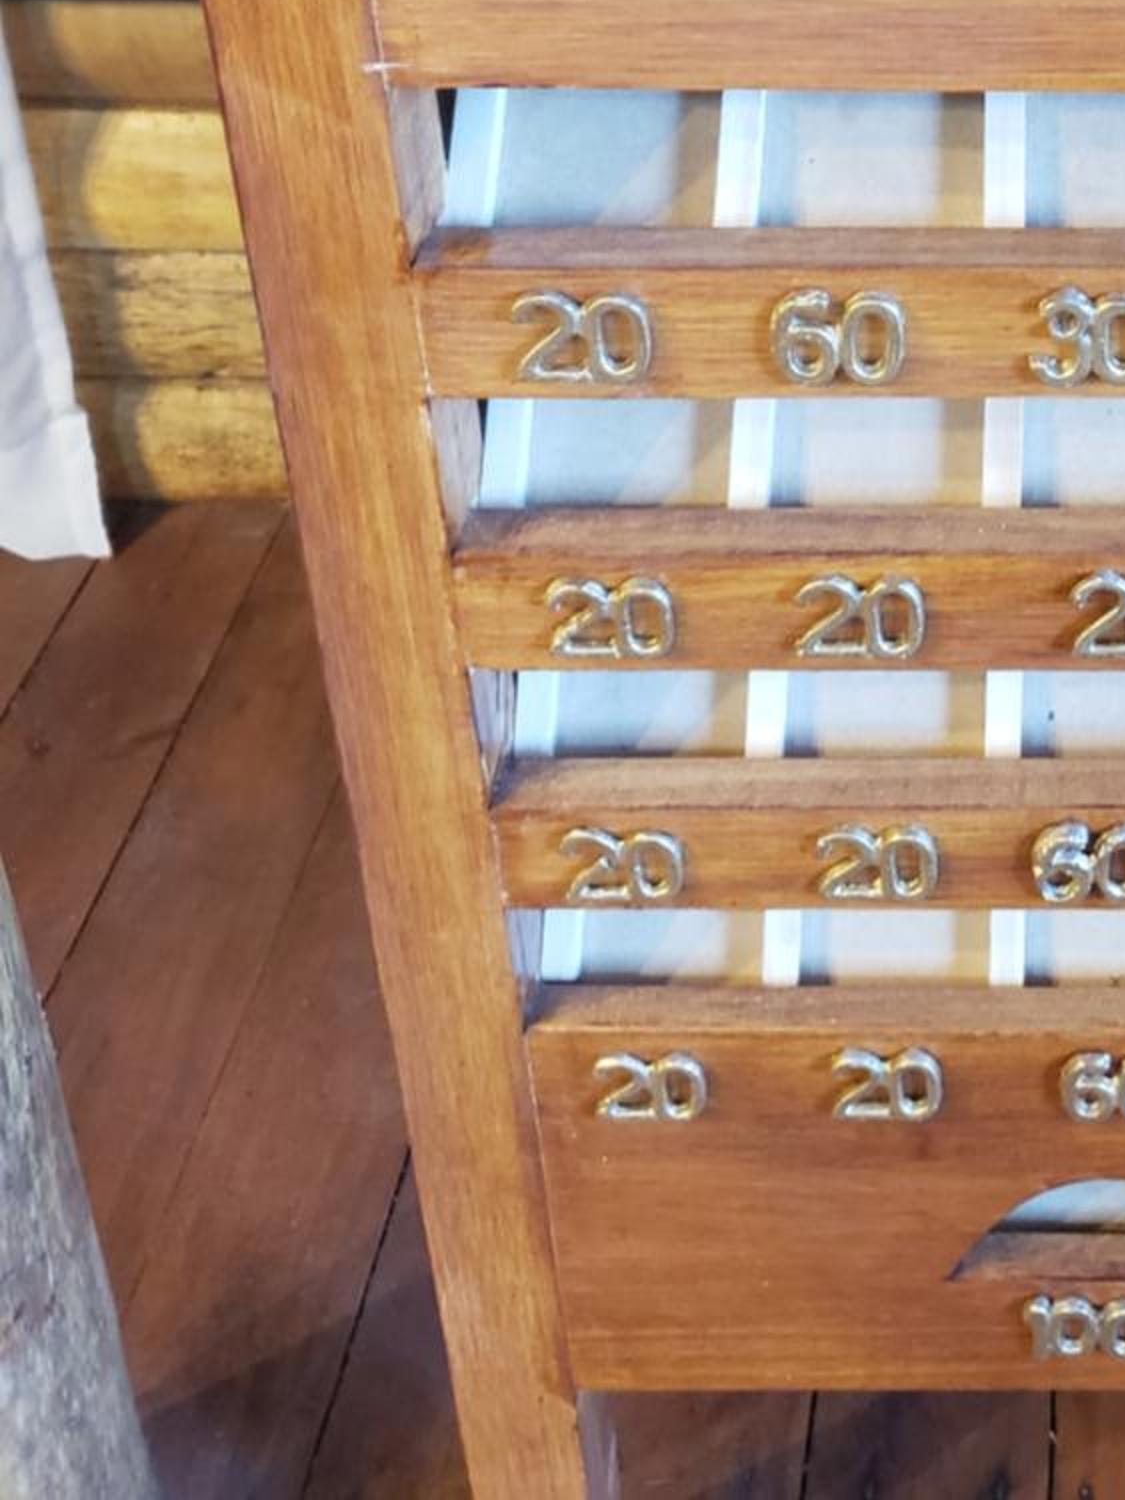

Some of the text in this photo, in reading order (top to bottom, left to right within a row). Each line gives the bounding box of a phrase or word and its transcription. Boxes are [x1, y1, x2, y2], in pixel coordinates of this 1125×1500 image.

[511, 290, 654, 385] 20
[769, 287, 907, 386] 60
[545, 575, 676, 660] 20
[795, 570, 927, 660] 20
[559, 825, 687, 900] 20
[816, 820, 939, 901] 20
[593, 1050, 707, 1122] 20
[829, 1046, 945, 1122] 20
